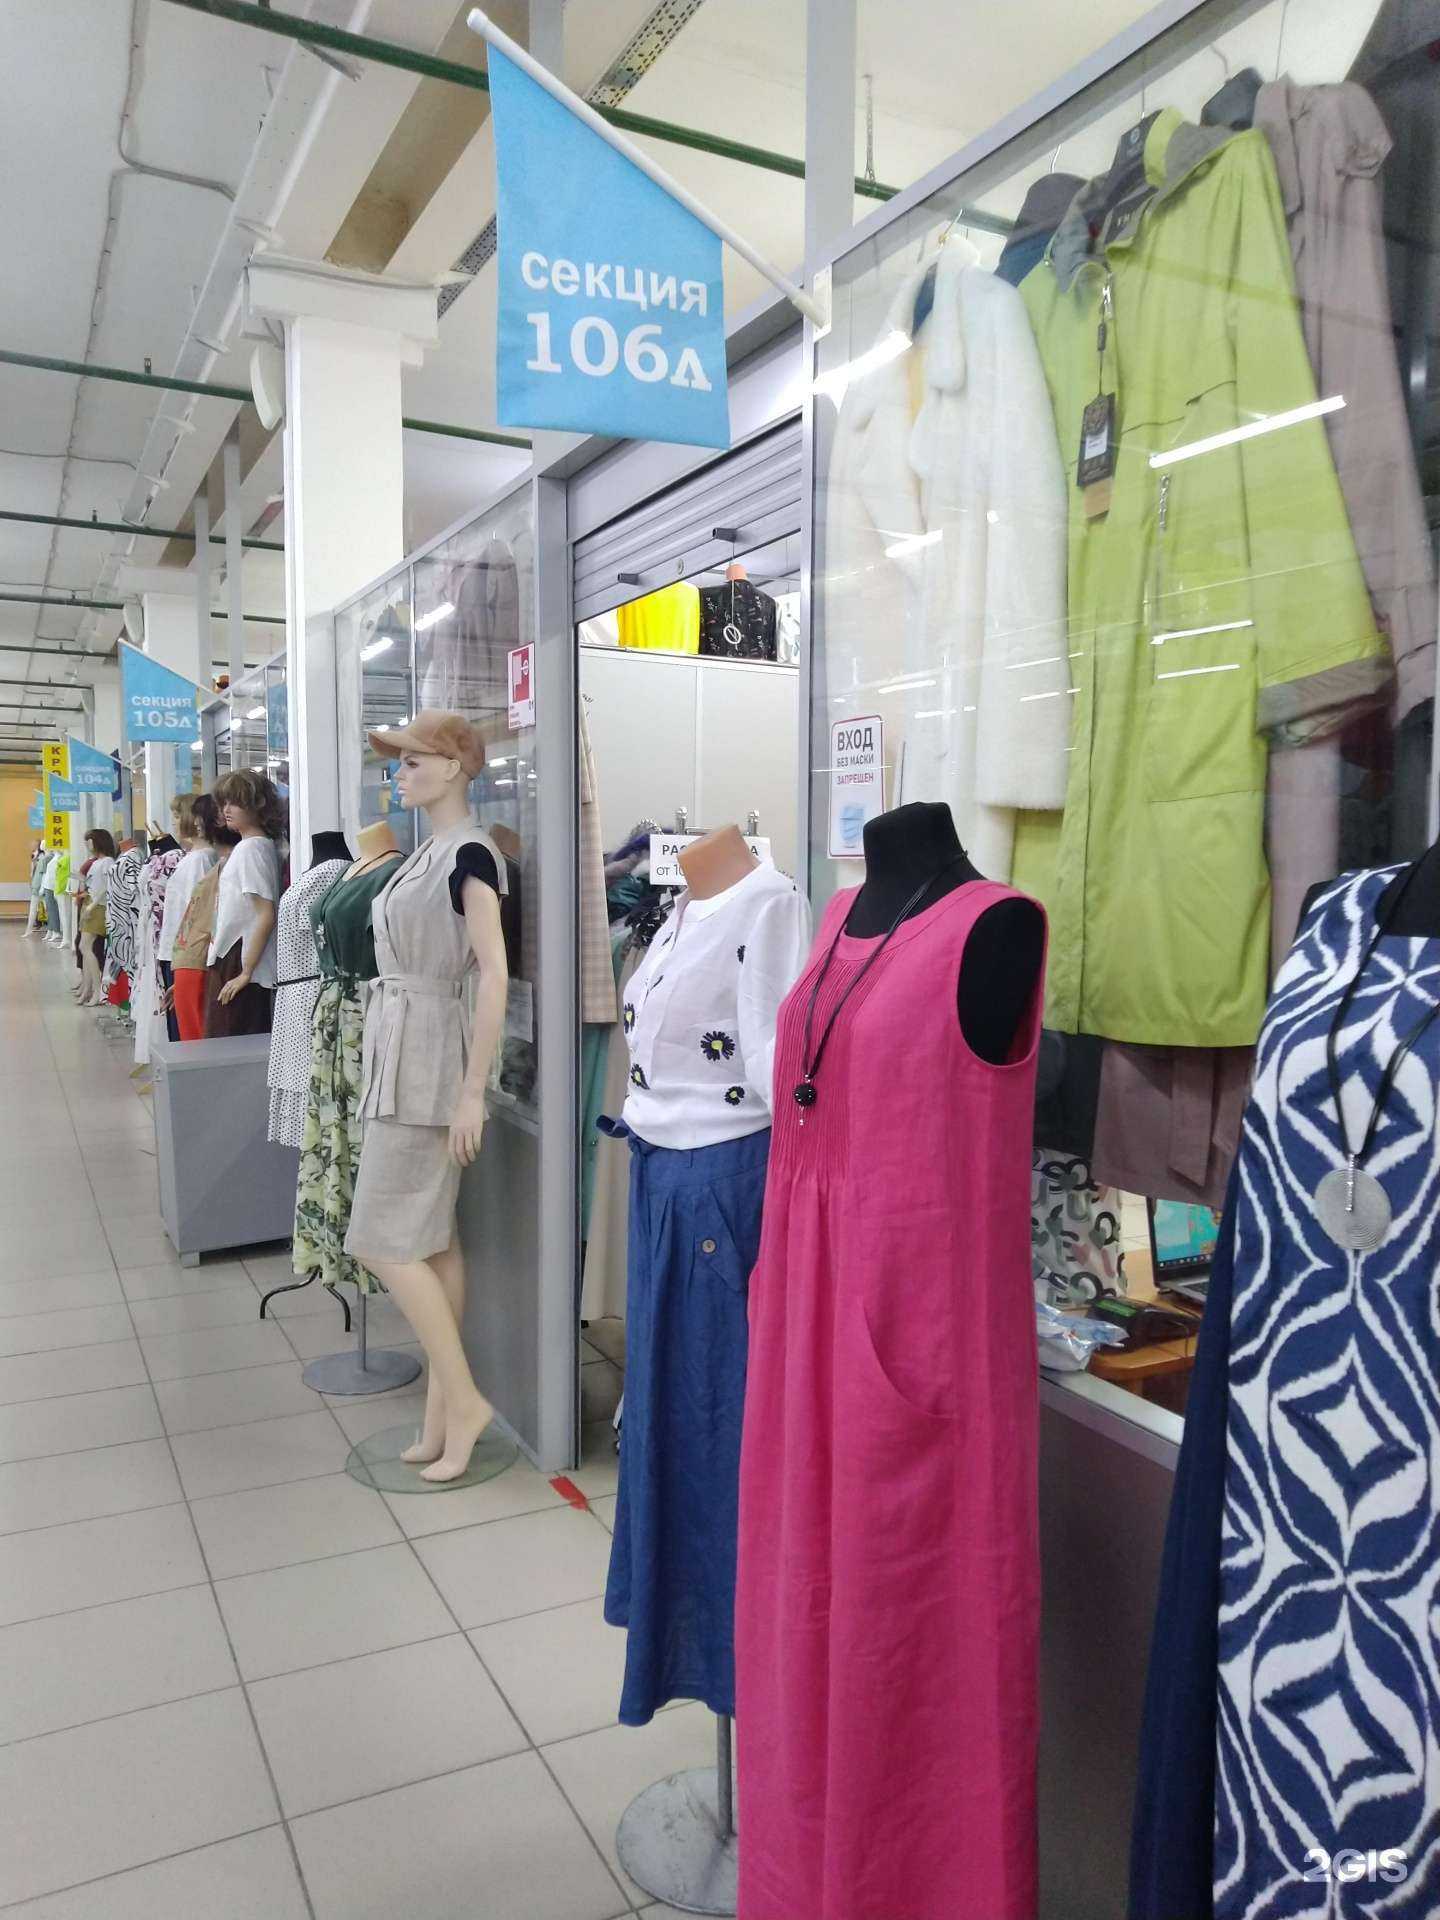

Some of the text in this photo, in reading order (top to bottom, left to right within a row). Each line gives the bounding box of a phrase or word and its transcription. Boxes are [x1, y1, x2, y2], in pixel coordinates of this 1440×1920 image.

[521, 251, 707, 317] секция
[131, 695, 192, 709] секция
[837, 727, 874, 752] ВХОД
[837, 754, 874, 768] БЕЗ МАСКИ
